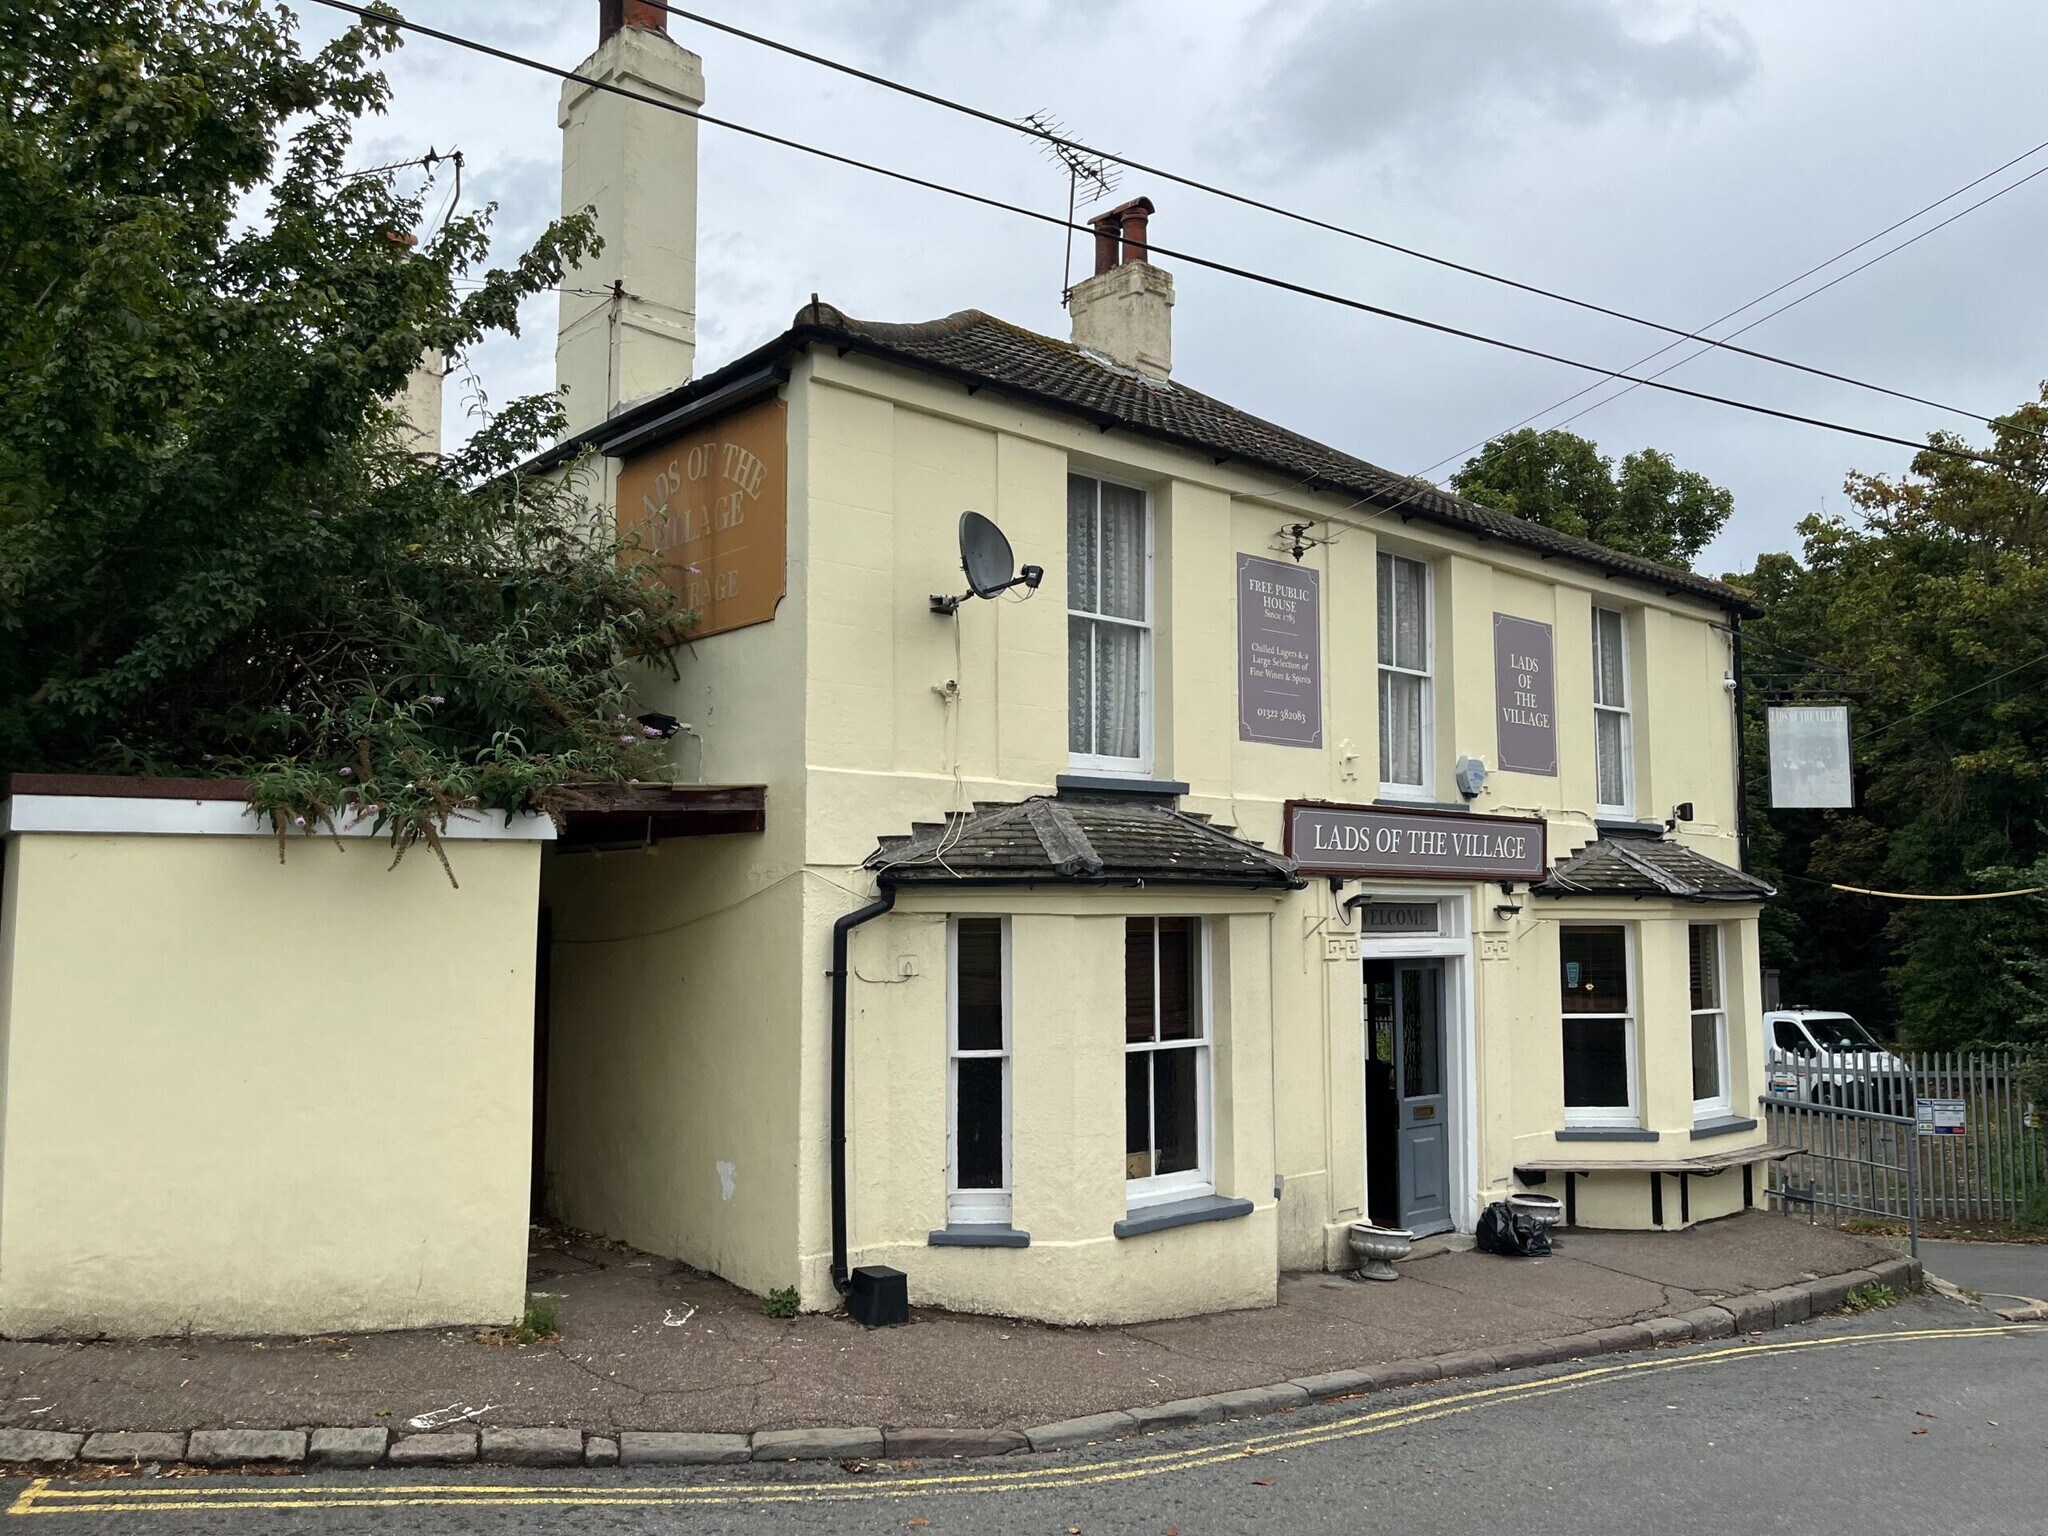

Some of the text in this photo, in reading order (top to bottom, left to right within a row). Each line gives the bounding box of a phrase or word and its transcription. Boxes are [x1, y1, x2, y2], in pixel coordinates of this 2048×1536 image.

[687, 442, 717, 482] OF
[722, 442, 768, 501] THE
[1249, 578, 1310, 602] FREE PUBLIC
[1263, 595, 1297, 613] HOUSE
[1264, 608, 1281, 620] Since
[1251, 642, 1275, 655] Chilled
[1276, 646, 1298, 660] Lagers
[1298, 651, 1304, 660] &
[1252, 654, 1309, 672] Large Selection of
[1511, 653, 1539, 673] LADS
[1250, 666, 1312, 685] Fine Wines & Spirits
[1518, 673, 1533, 690] OF
[1514, 691, 1538, 709] THE
[1257, 707, 1306, 724] 01322 382083
[1502, 707, 1550, 729] VILLAGE
[1313, 824, 1526, 859] LADS OF THE VILLAGE
